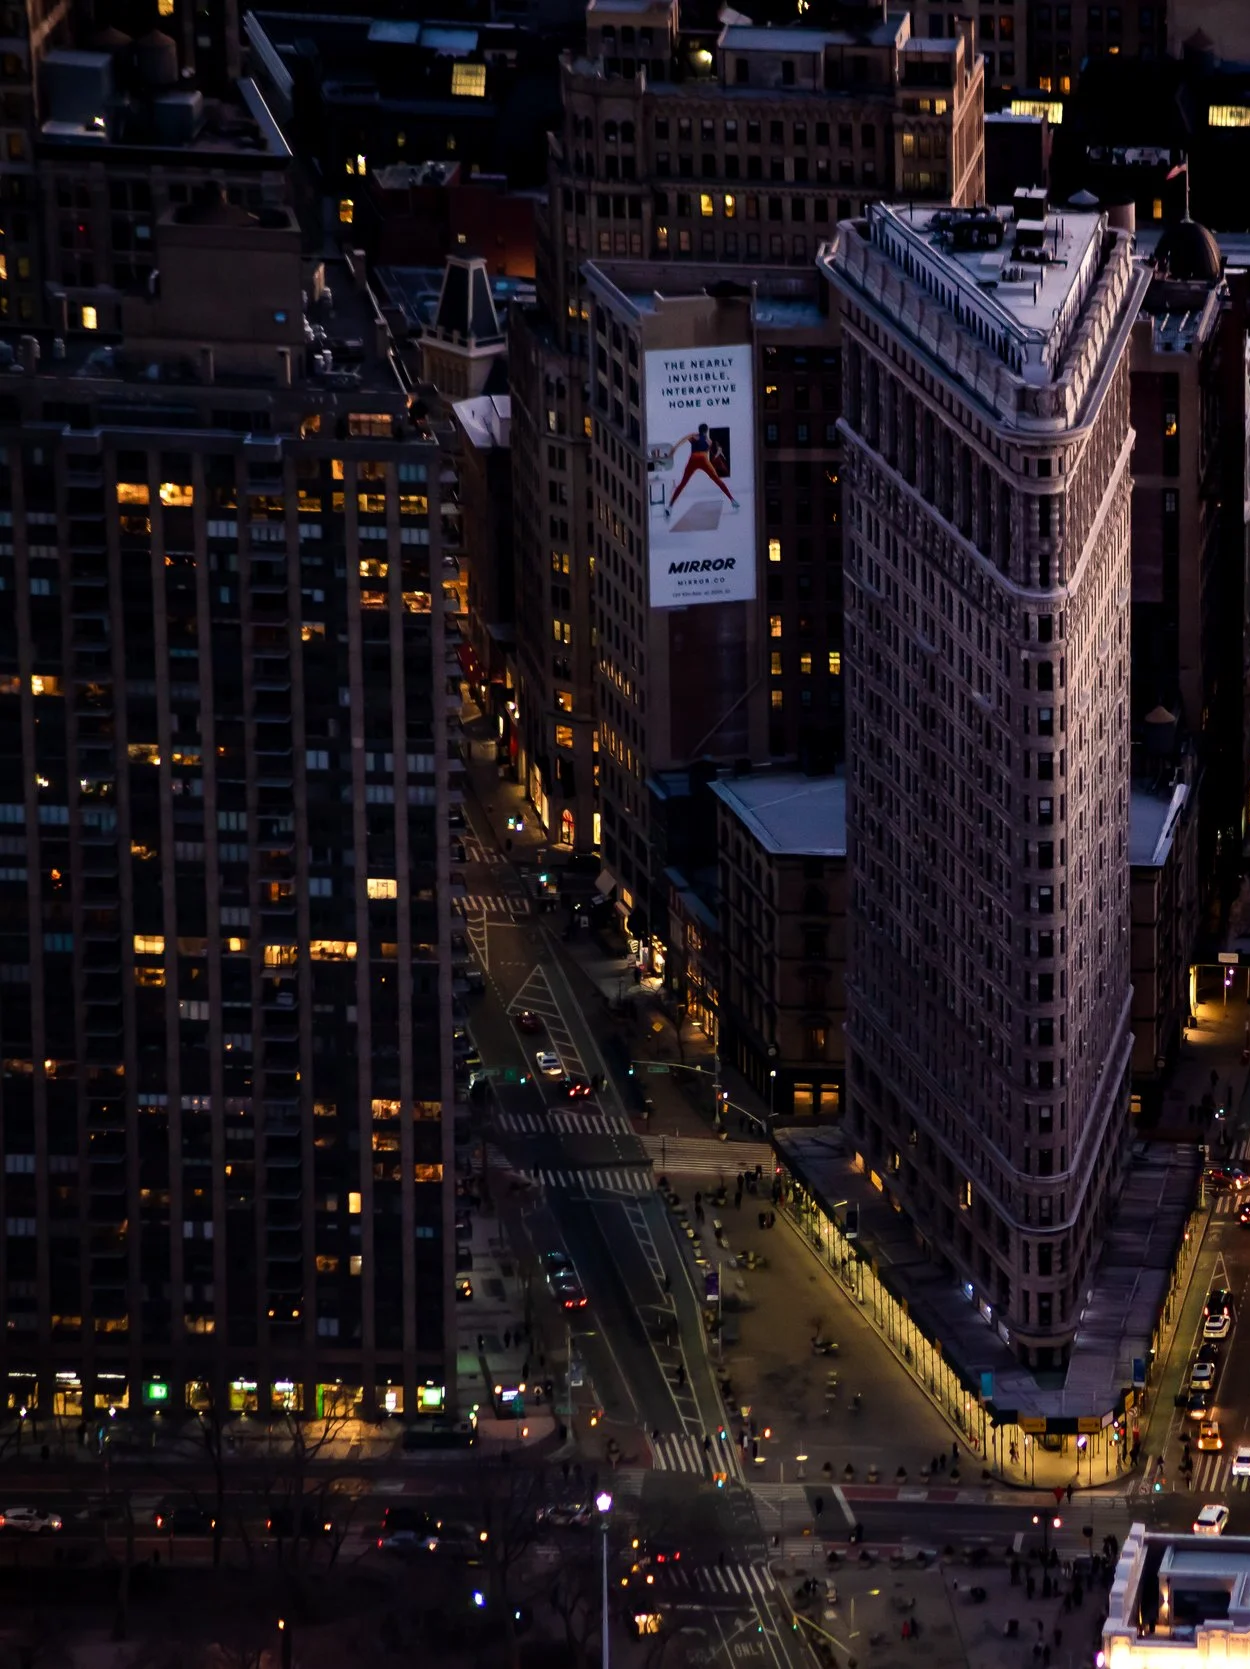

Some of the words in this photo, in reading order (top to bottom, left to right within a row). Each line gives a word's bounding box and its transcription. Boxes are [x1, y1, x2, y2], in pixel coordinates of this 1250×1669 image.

[664, 360, 685, 370] THE
[691, 358, 733, 369] NEARLY
[661, 384, 736, 397] INTERACTIVE
[669, 399, 701, 409] HOME
[706, 396, 730, 406] GYM
[668, 557, 736, 575] MIRROR
